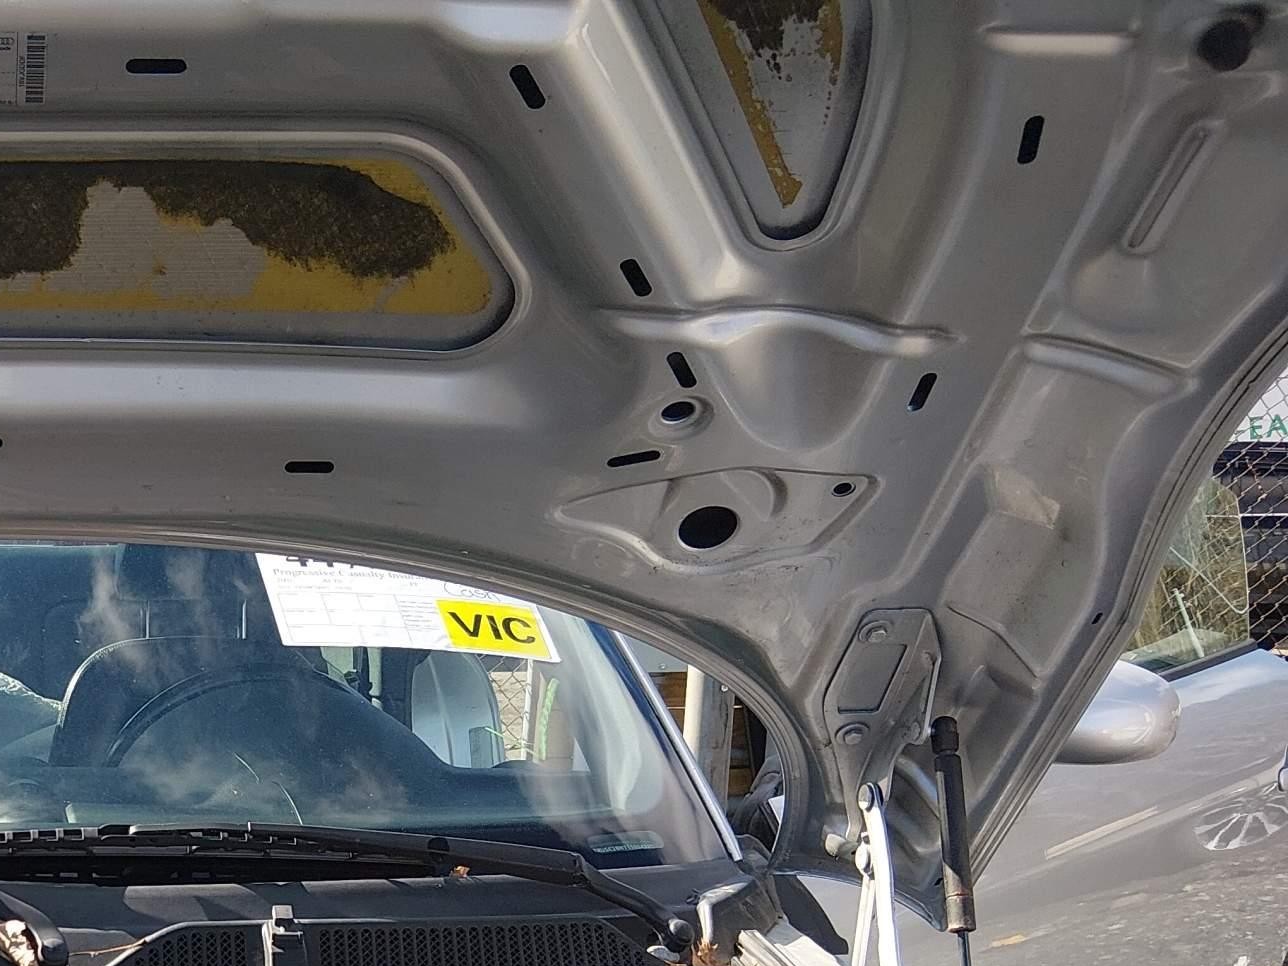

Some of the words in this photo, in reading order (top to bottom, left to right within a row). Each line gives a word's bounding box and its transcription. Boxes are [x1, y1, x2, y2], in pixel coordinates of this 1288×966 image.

[272, 568, 336, 578] Progressive
[338, 568, 386, 580] Casualty
[447, 611, 535, 645] VIC
